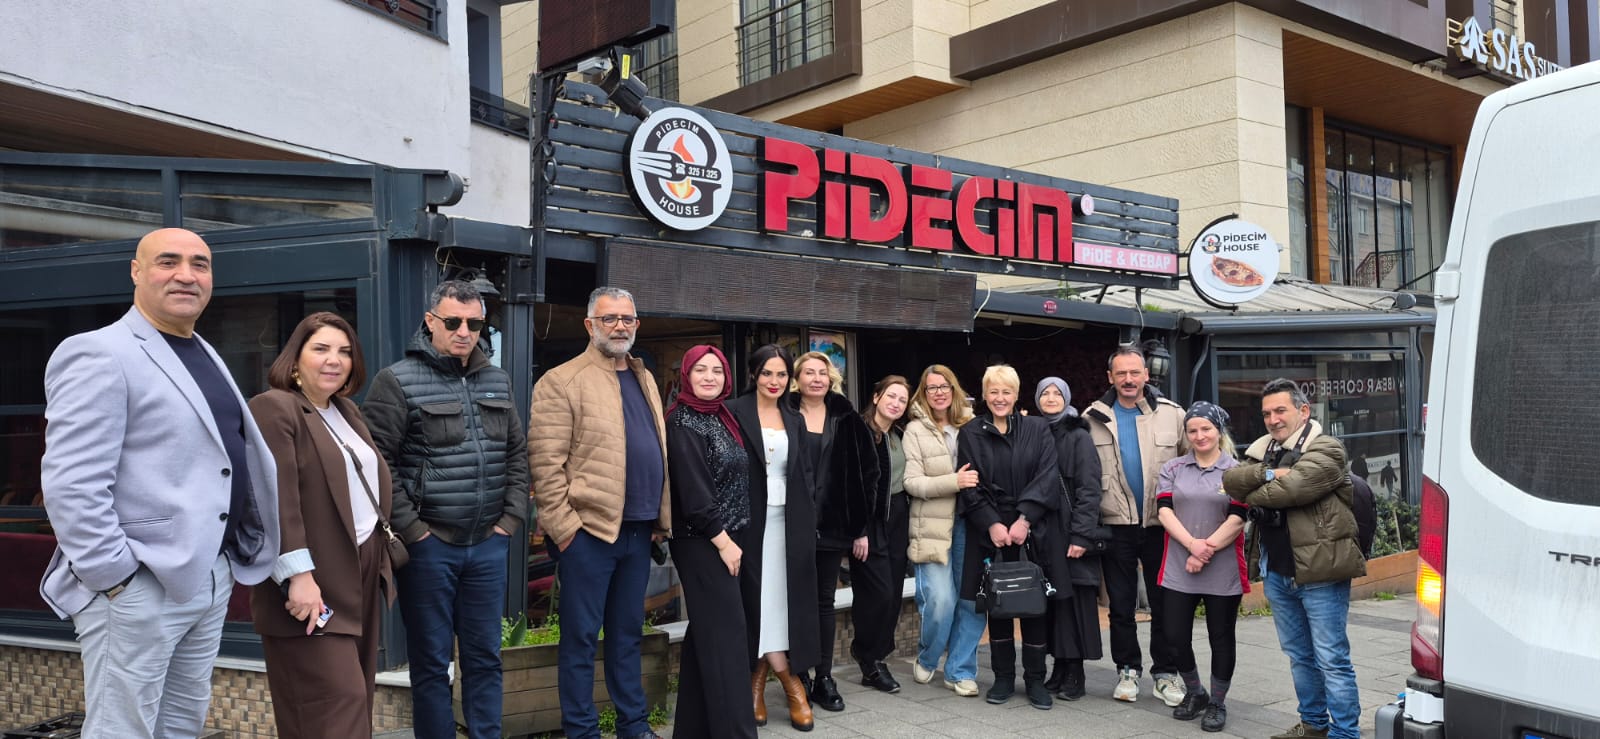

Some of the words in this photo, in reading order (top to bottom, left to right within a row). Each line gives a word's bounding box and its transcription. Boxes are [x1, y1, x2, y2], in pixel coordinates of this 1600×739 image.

[1492, 28, 1537, 80] SAS
[656, 120, 700, 138] PİDECİM
[688, 167, 700, 177] 325
[705, 169, 718, 179] 325
[659, 197, 700, 215] HOUSE
[1223, 243, 1260, 252] HOUSE
[1116, 250, 1127, 267] &
[1129, 252, 1172, 270] KEBAP
